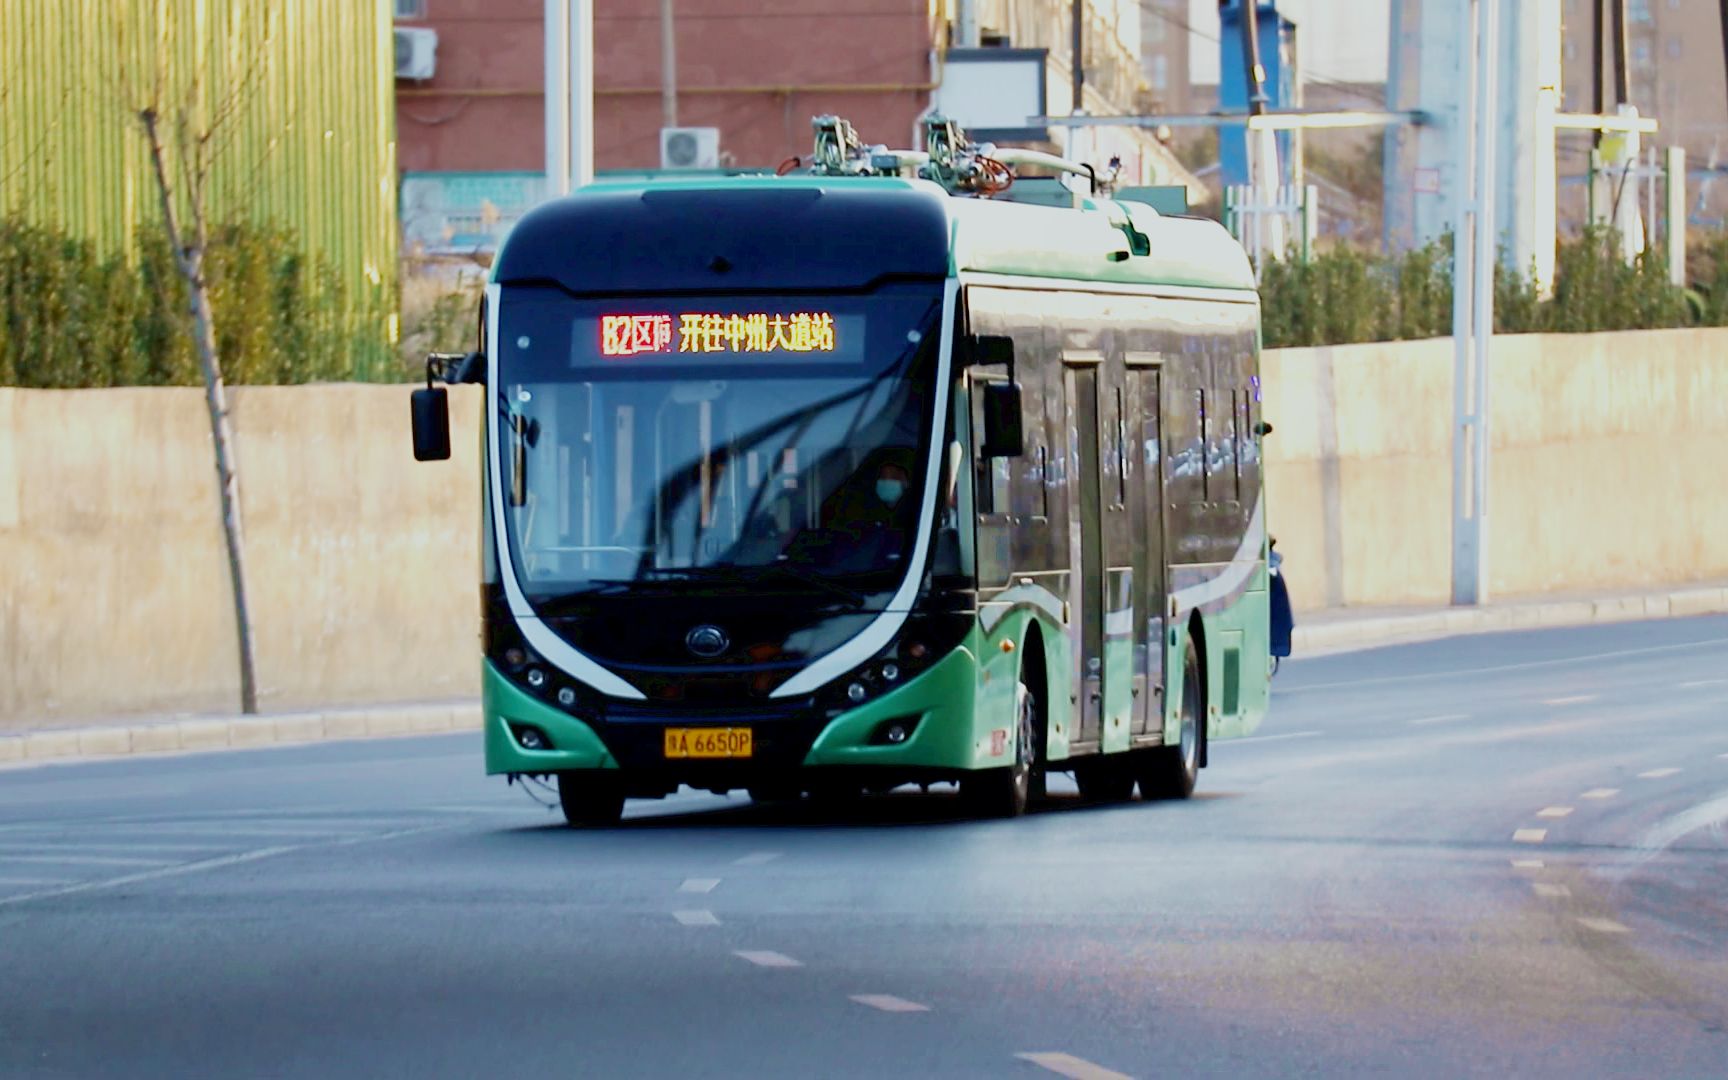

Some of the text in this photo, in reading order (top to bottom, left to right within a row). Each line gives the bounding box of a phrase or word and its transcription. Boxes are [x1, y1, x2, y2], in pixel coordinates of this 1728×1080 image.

[679, 312, 833, 352] 开往中州大道站
